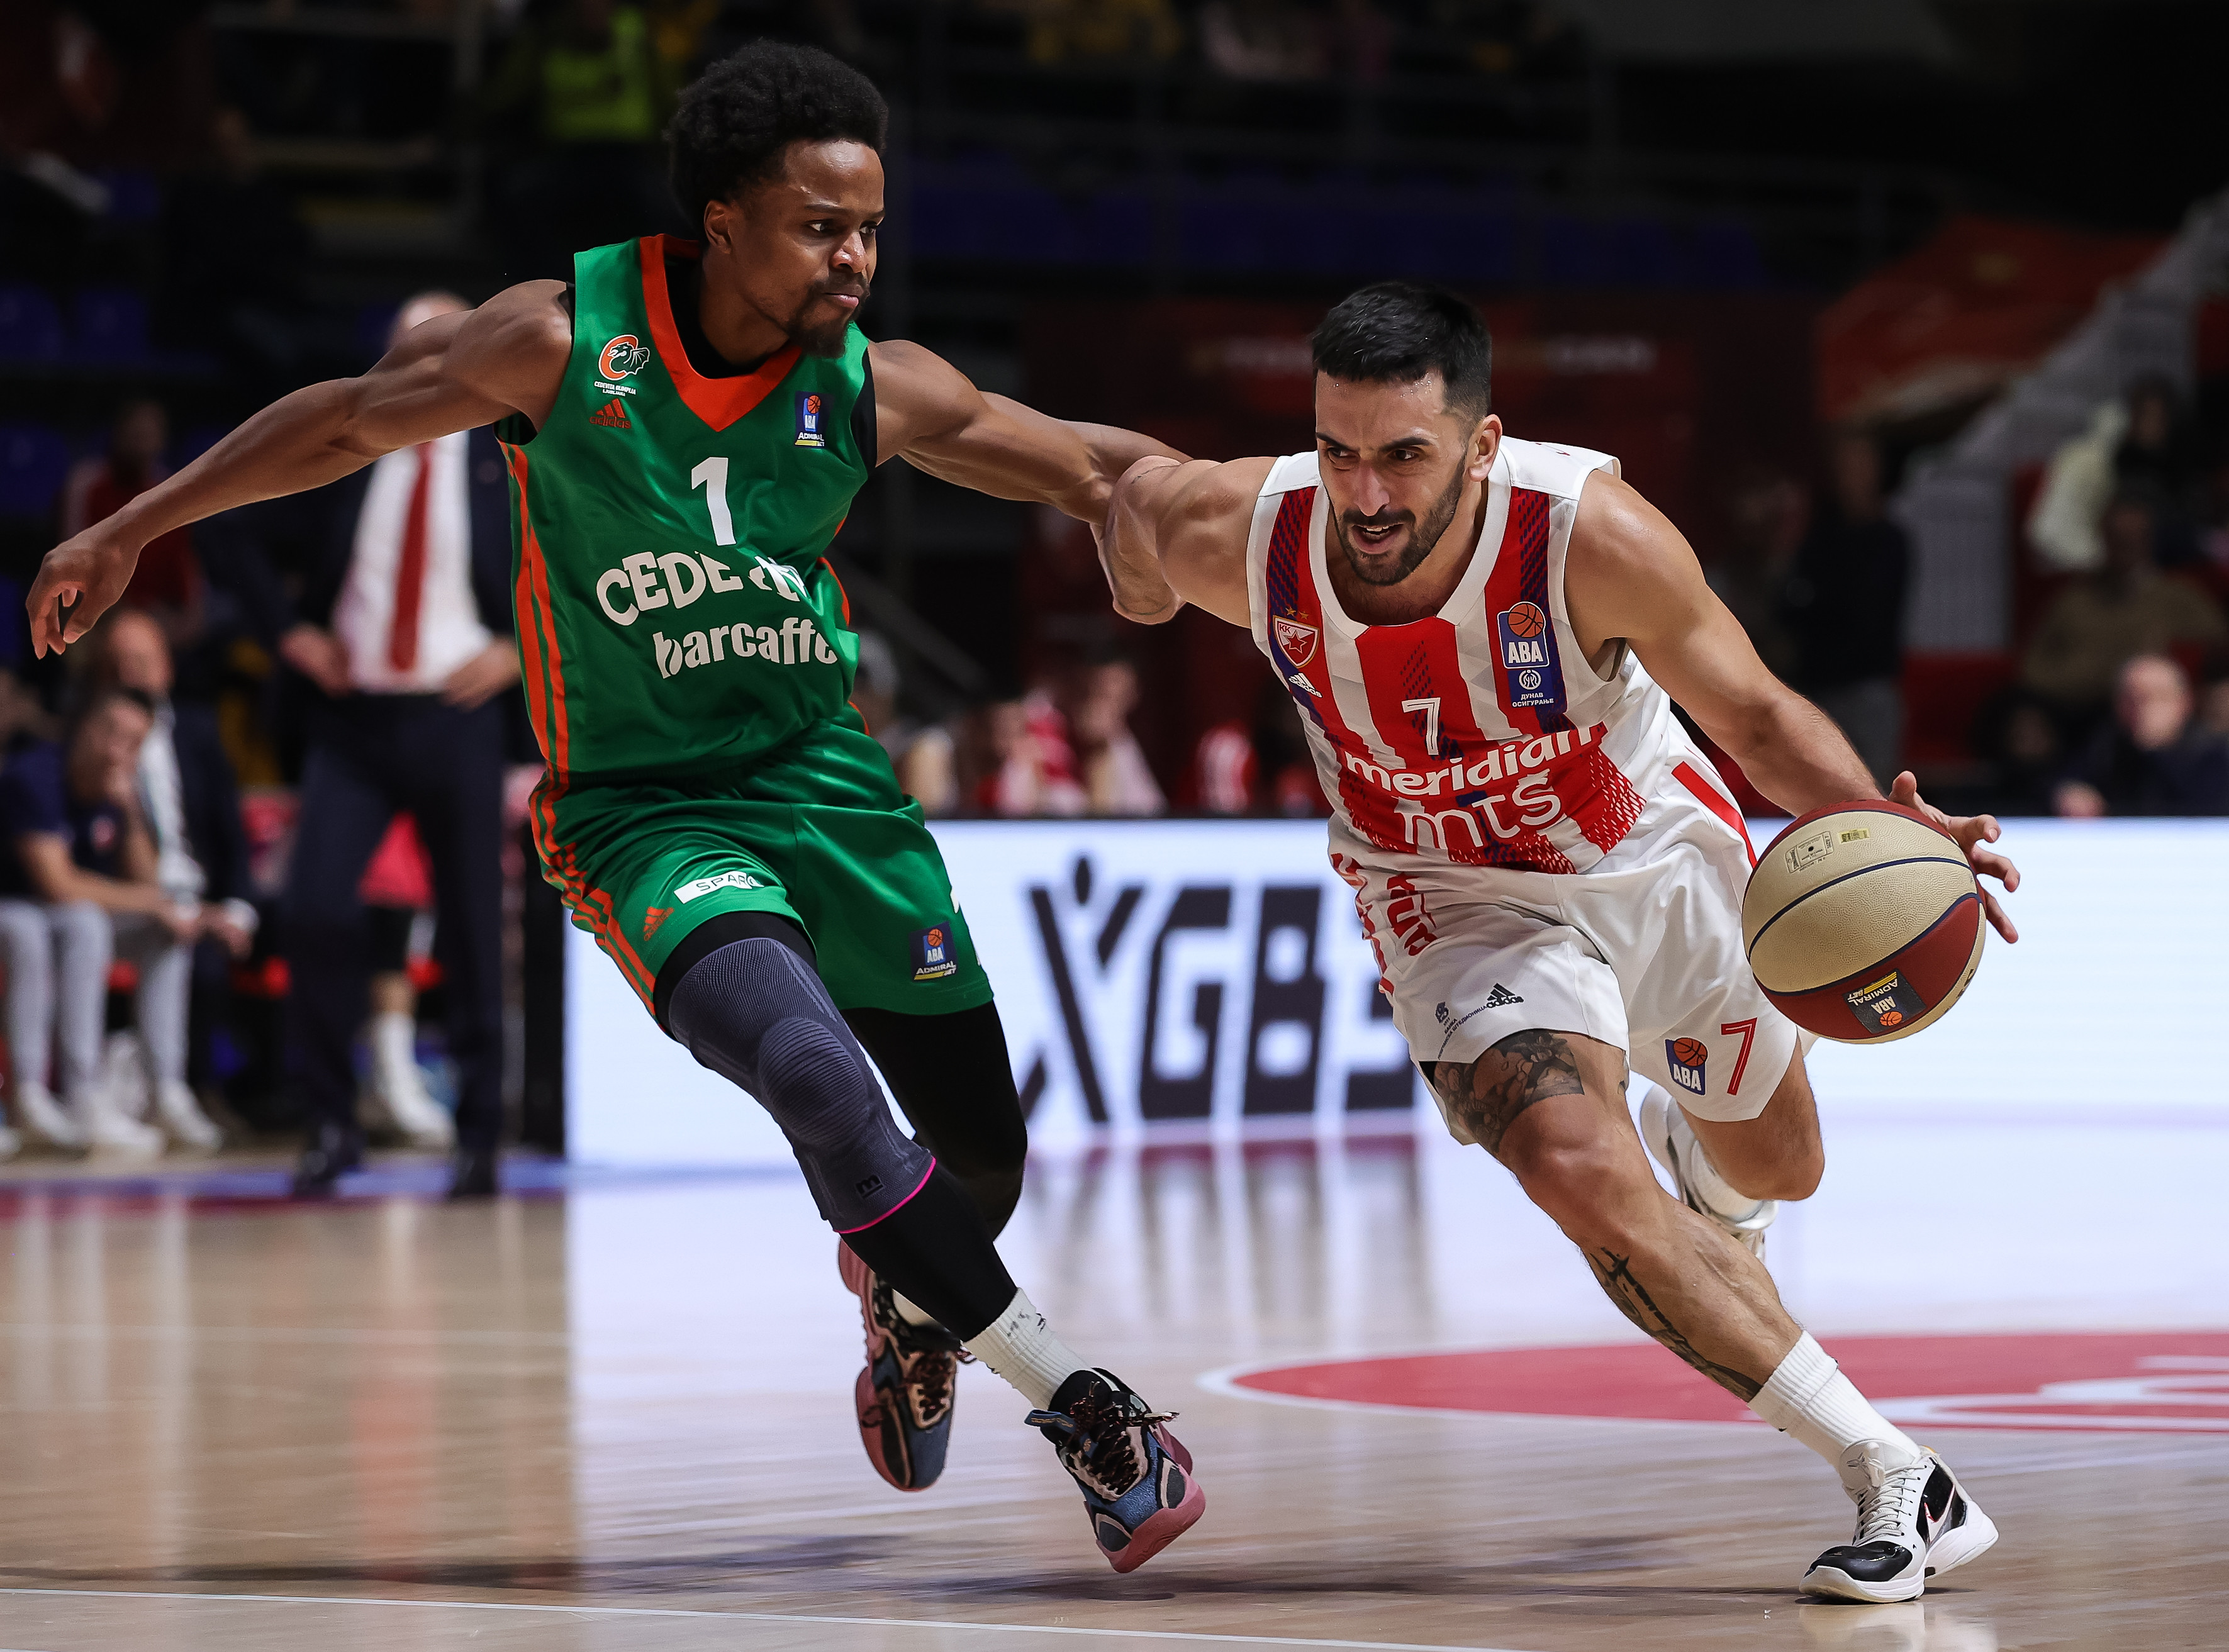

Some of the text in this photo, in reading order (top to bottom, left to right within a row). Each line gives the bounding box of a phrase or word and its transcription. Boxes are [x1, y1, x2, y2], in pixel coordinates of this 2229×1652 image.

[589, 414, 632, 429] adidas
[691, 457, 736, 546] 1
[1279, 623, 1291, 634] KK
[1508, 640, 1543, 664] ABA
[1512, 698, 1555, 708] ОСИГУРАЊЕ
[1521, 692, 1544, 701] ДУНАВ
[1401, 697, 1441, 756] 7
[1399, 775, 1561, 850] mts
[927, 946, 944, 963] ABA
[1848, 978, 1898, 1006] ADMIRAL
[1870, 996, 1896, 1014] ABA
[1721, 1017, 1758, 1096] 7
[1673, 1063, 1702, 1091] ABA
